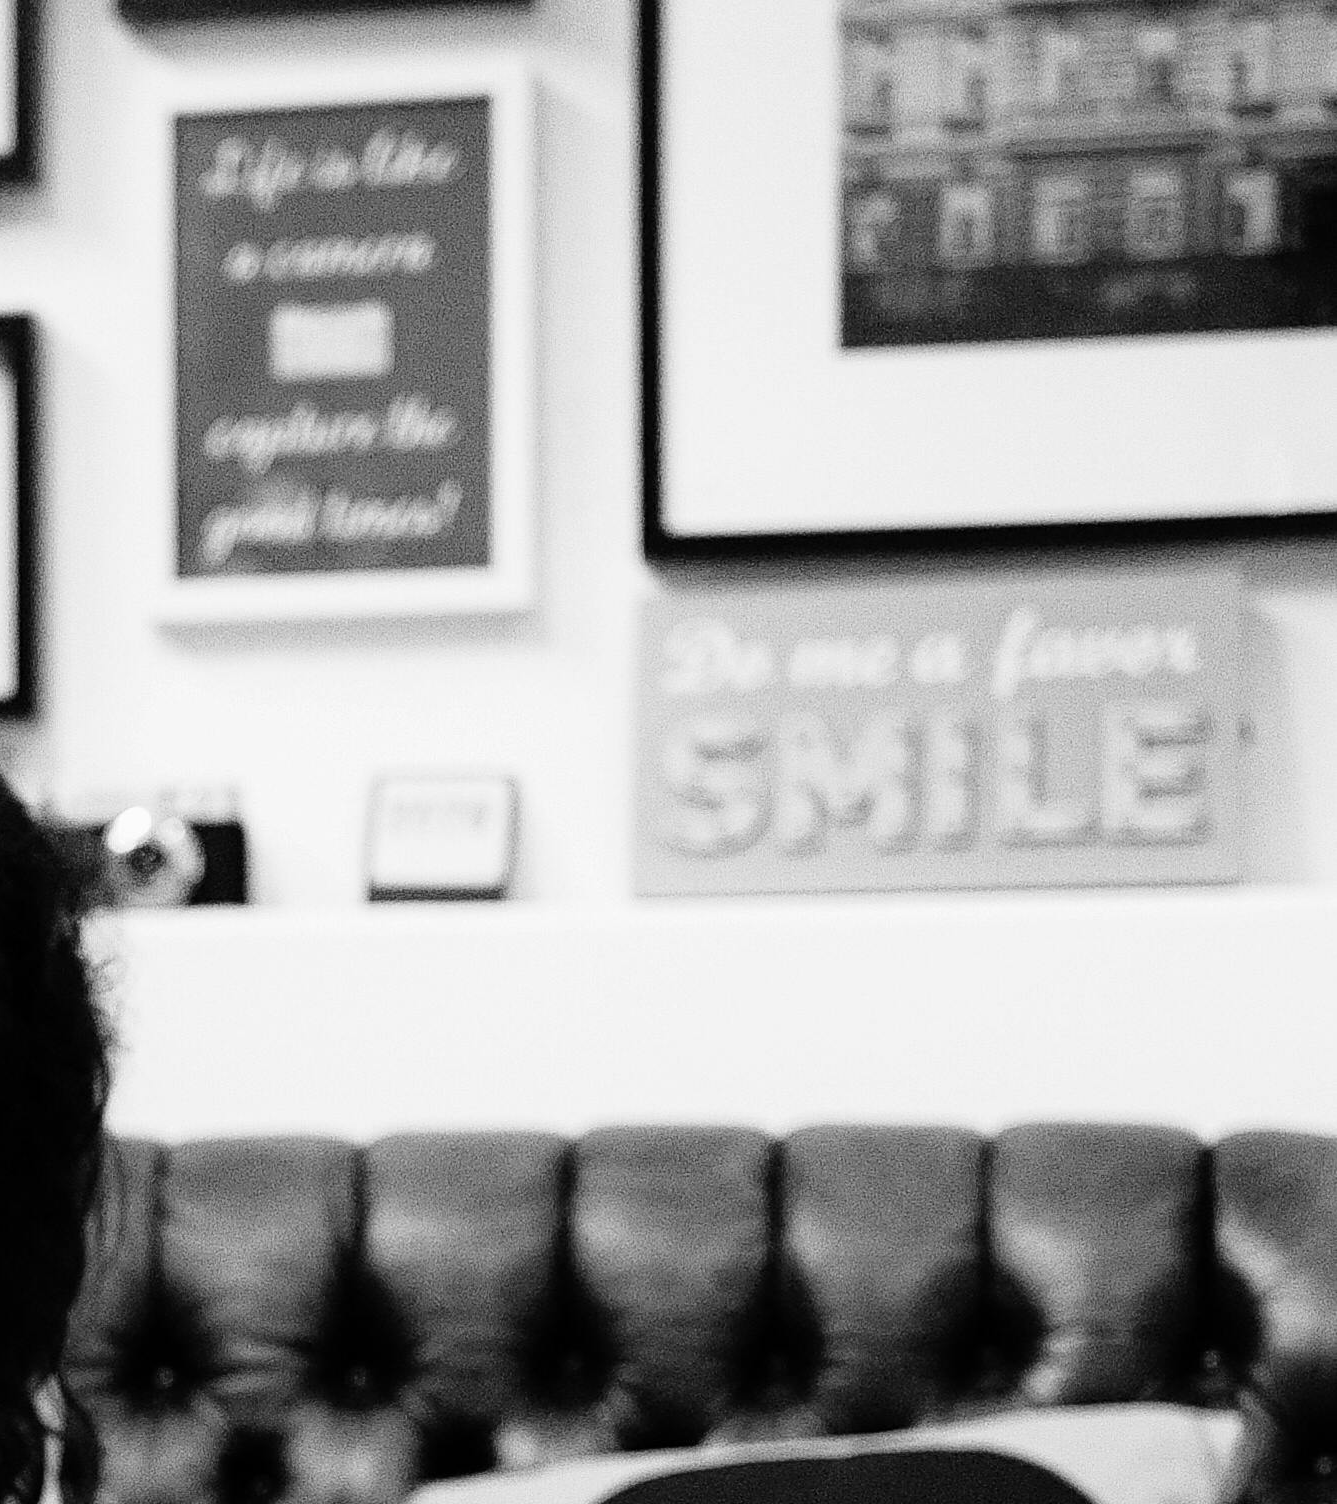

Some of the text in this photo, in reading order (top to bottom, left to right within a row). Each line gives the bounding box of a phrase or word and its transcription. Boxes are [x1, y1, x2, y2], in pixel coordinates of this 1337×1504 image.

[787, 633, 903, 689] me
[911, 631, 968, 686] a
[660, 702, 1214, 861] SMILE
